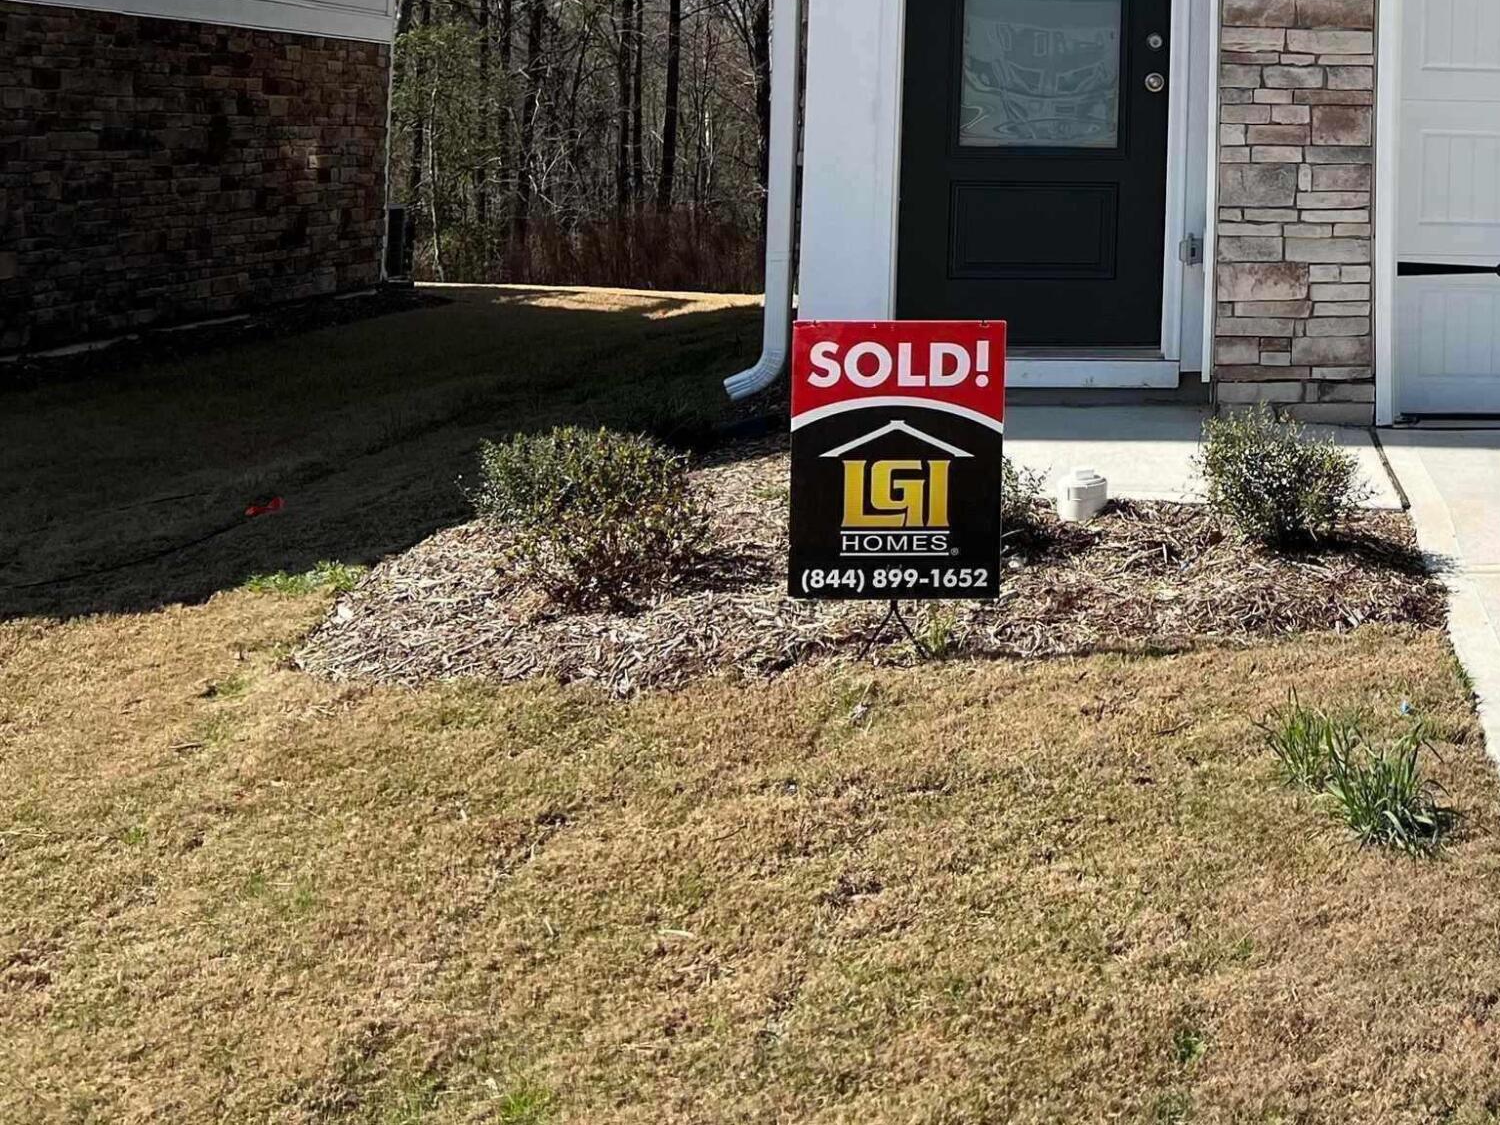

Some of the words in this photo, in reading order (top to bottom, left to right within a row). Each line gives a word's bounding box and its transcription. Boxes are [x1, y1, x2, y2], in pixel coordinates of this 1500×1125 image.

[807, 340, 990, 388] SOLD!
[841, 459, 951, 528] LGI
[841, 535, 948, 552] HOMES
[801, 569, 865, 593] (844)
[872, 568, 988, 588] 899-1652
